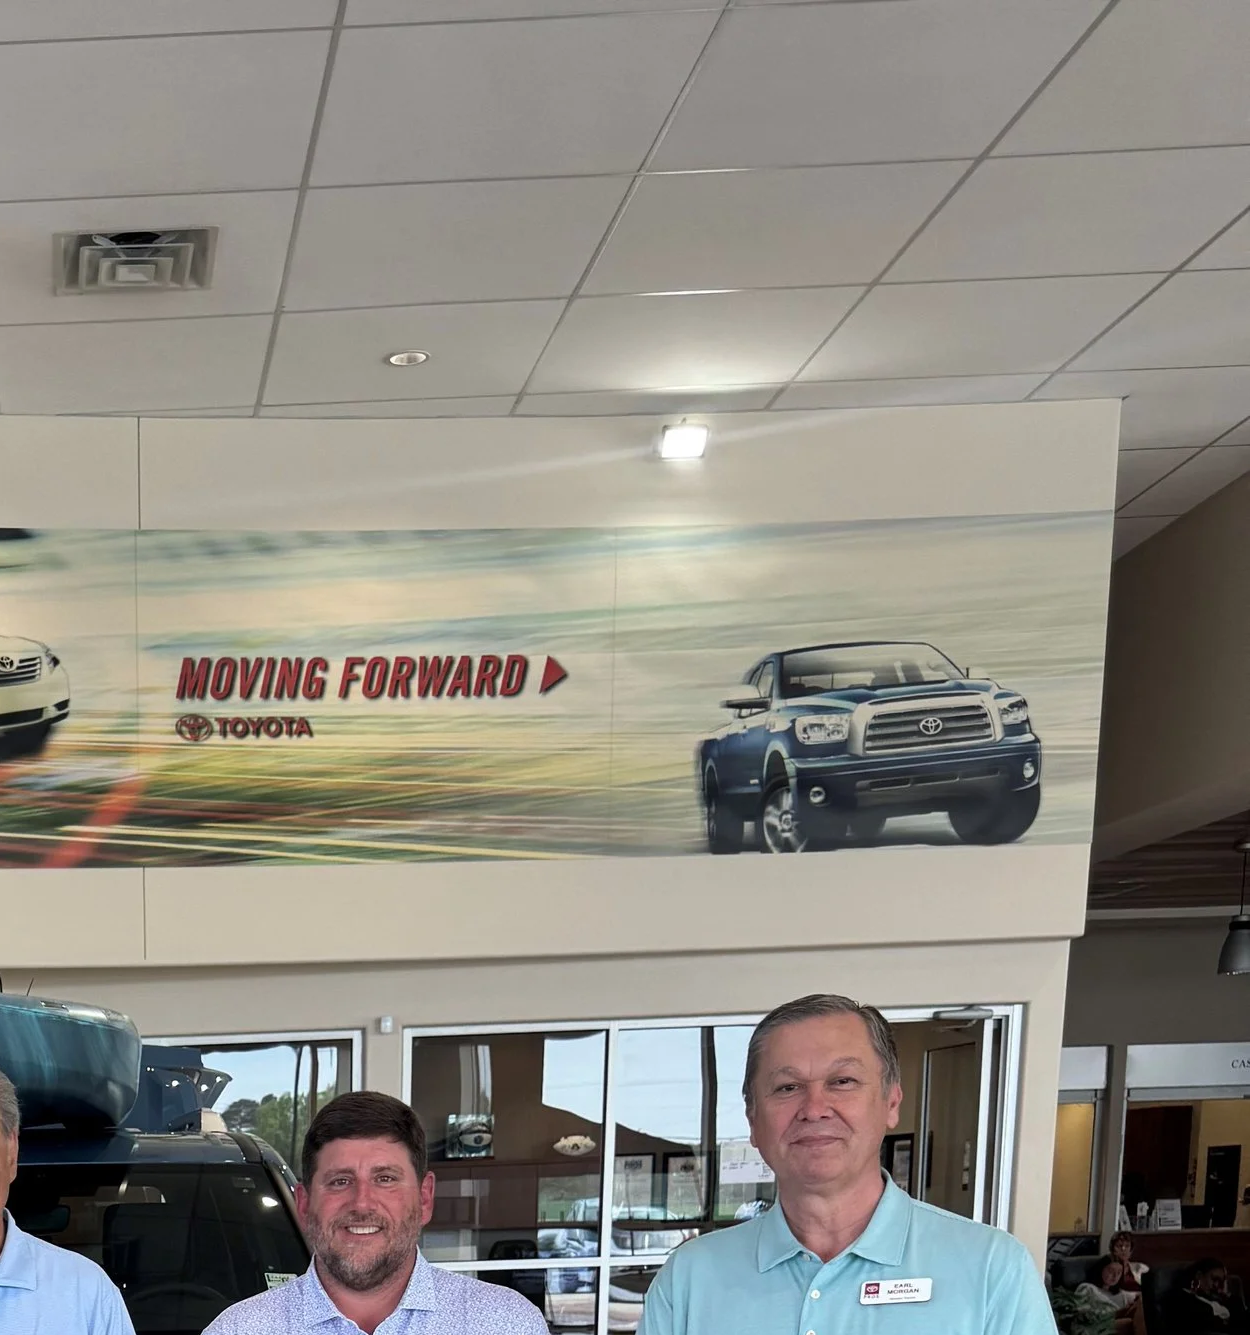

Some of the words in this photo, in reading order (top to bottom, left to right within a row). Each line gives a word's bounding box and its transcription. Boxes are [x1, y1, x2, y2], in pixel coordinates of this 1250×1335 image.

[176, 656, 327, 701] MOVING
[338, 654, 529, 699] FORWARD
[215, 716, 313, 738] TOYOTA
